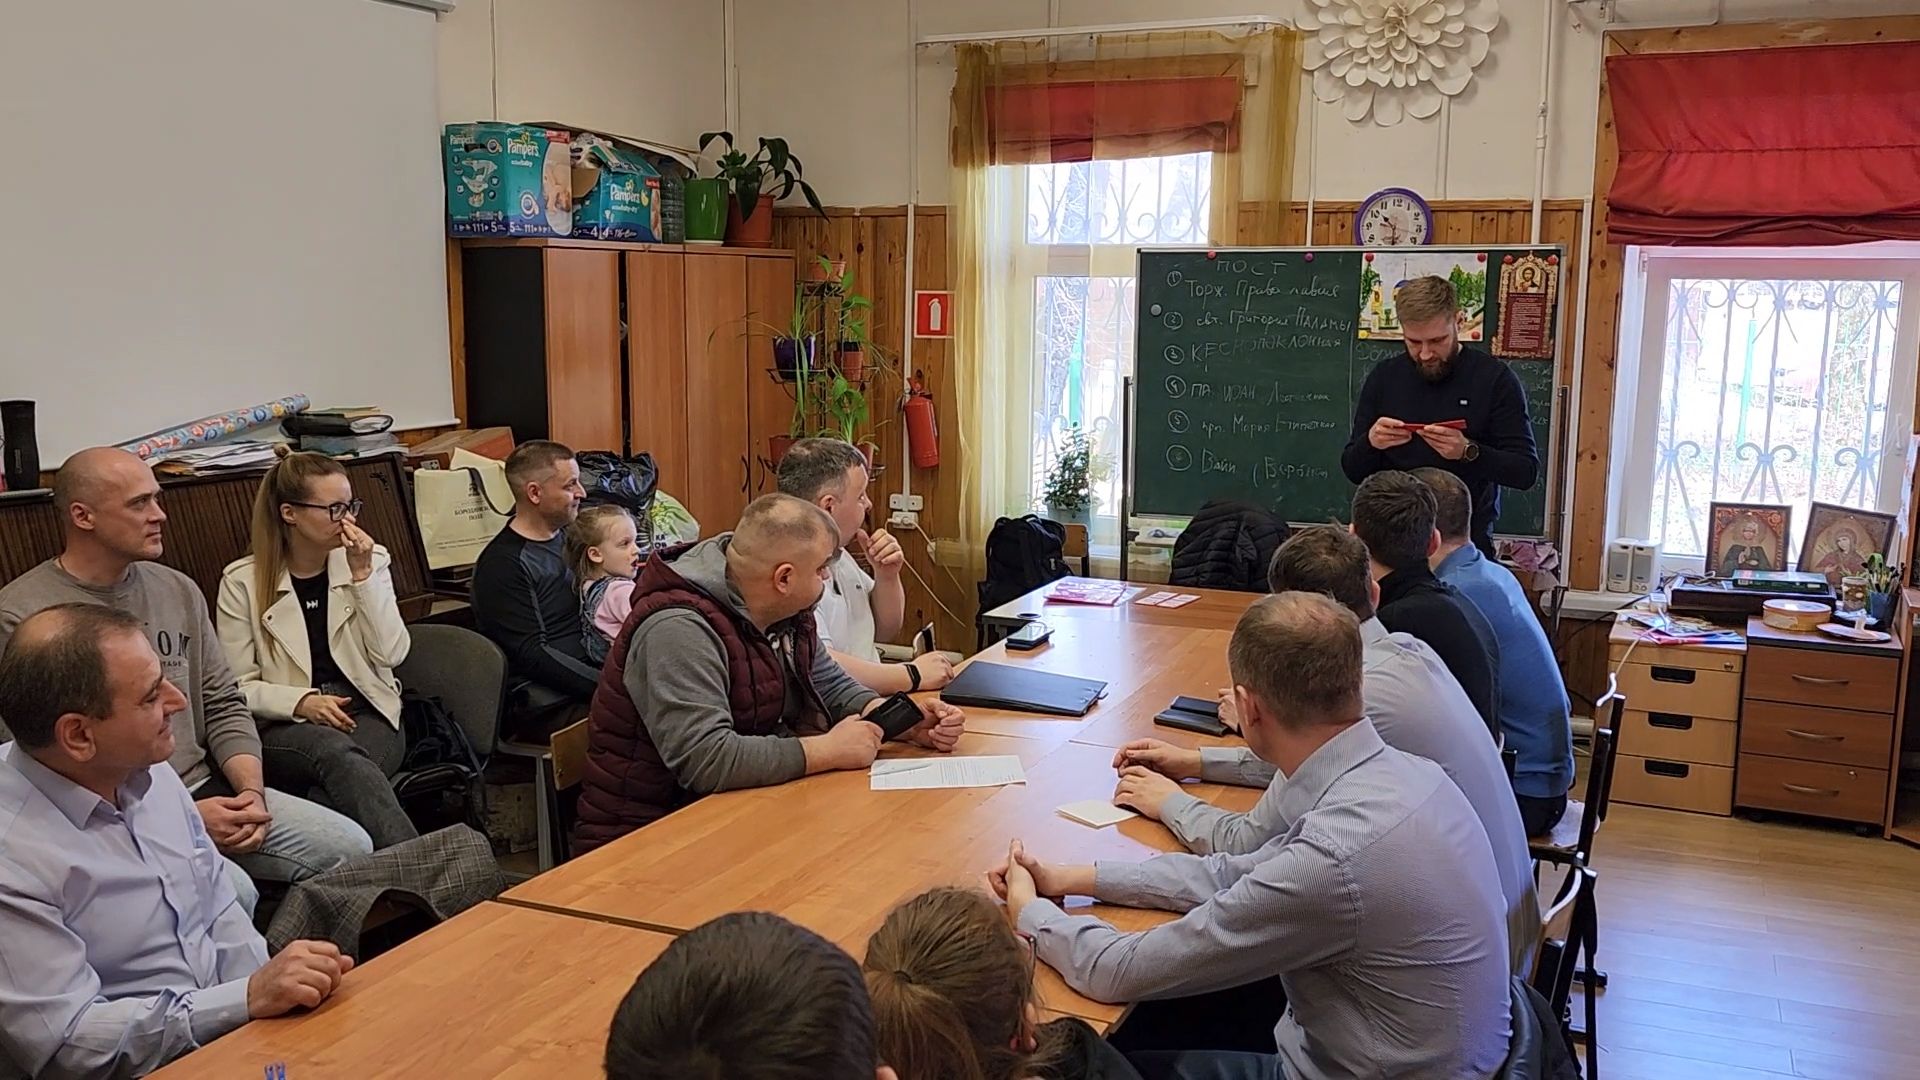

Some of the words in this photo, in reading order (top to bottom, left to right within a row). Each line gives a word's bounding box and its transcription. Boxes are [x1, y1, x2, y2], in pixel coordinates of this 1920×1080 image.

[507, 137, 540, 159] Pampers
[610, 183, 641, 204] Pampers
[1393, 199, 1402, 207] 12
[1371, 210, 1380, 218] 10
[1366, 222, 1372, 230] 9
[1217, 260, 1287, 275] ПОСТ
